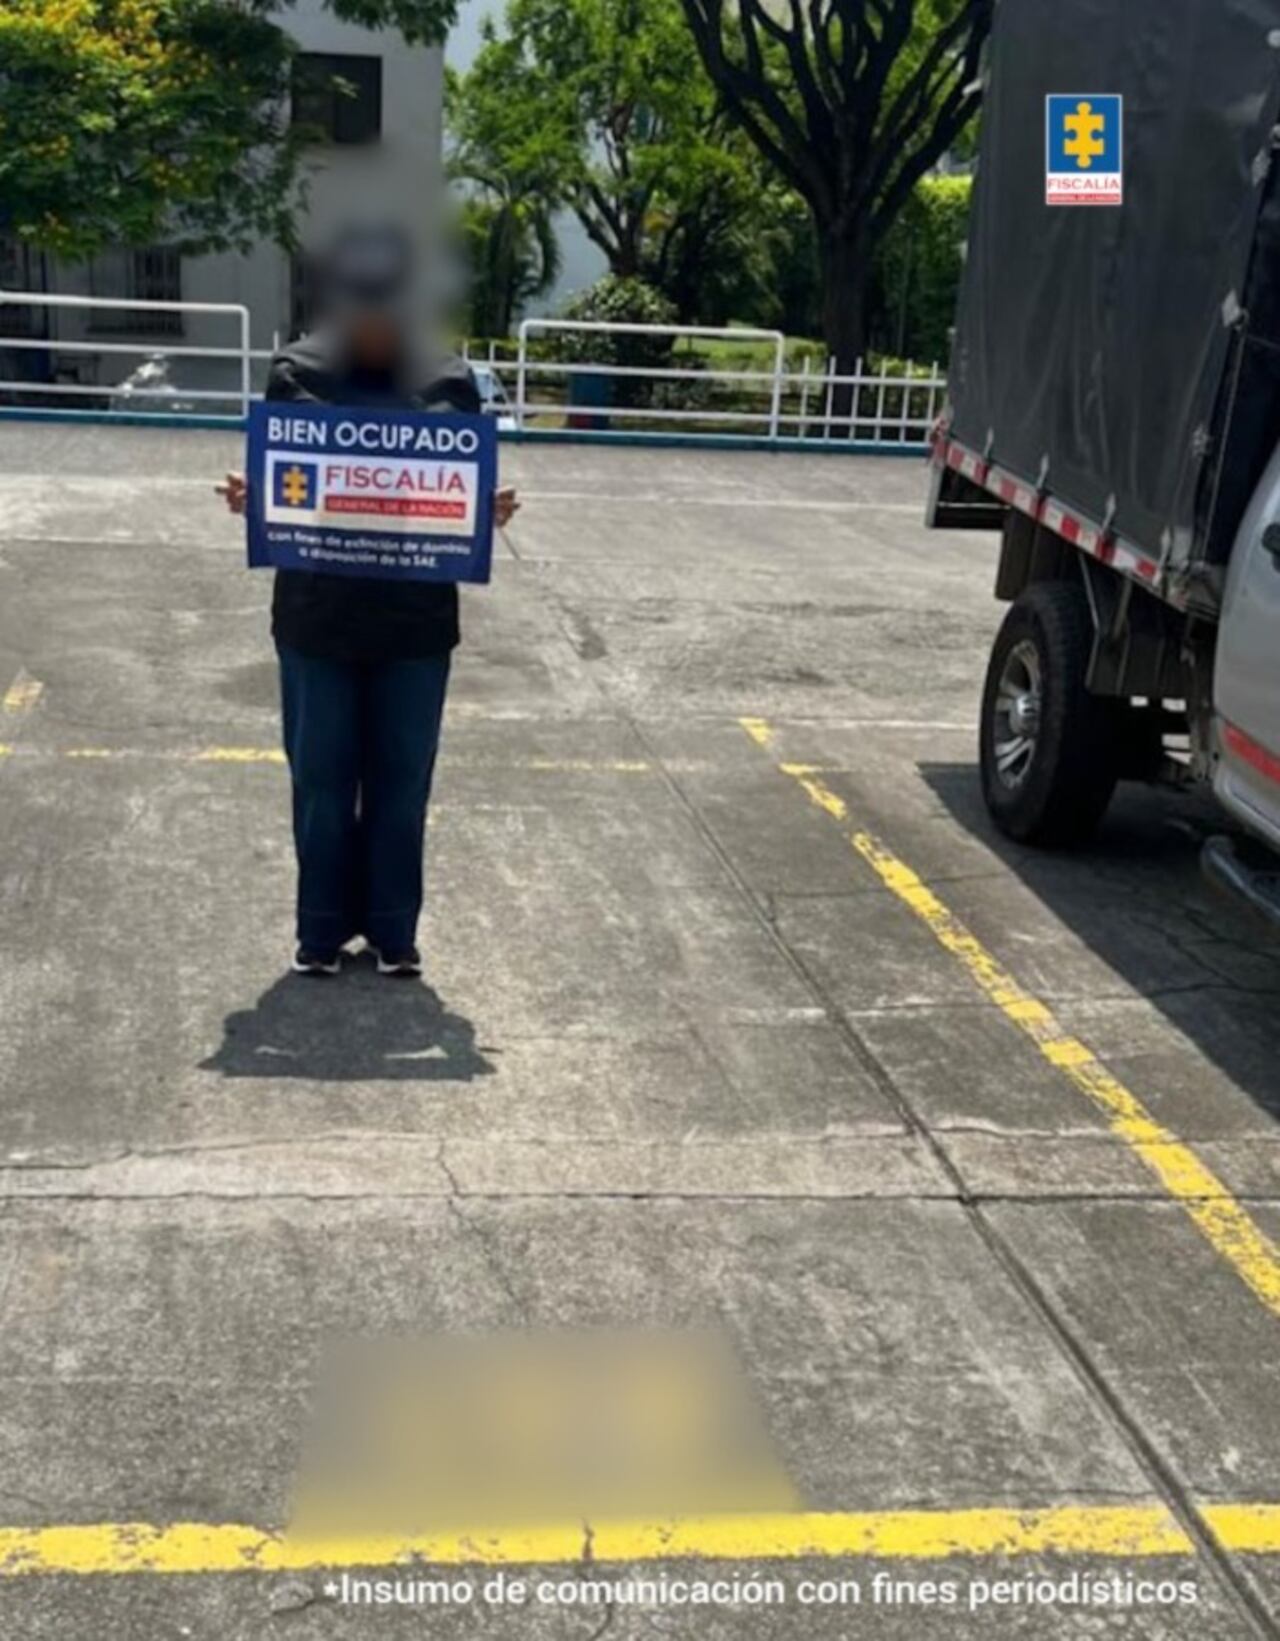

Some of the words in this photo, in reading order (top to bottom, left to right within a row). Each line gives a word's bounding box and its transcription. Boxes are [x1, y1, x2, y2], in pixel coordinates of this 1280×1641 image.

[267, 417, 326, 444] BIEN
[335, 421, 478, 453] OCUPADO
[325, 465, 466, 493] FISCALÍA
